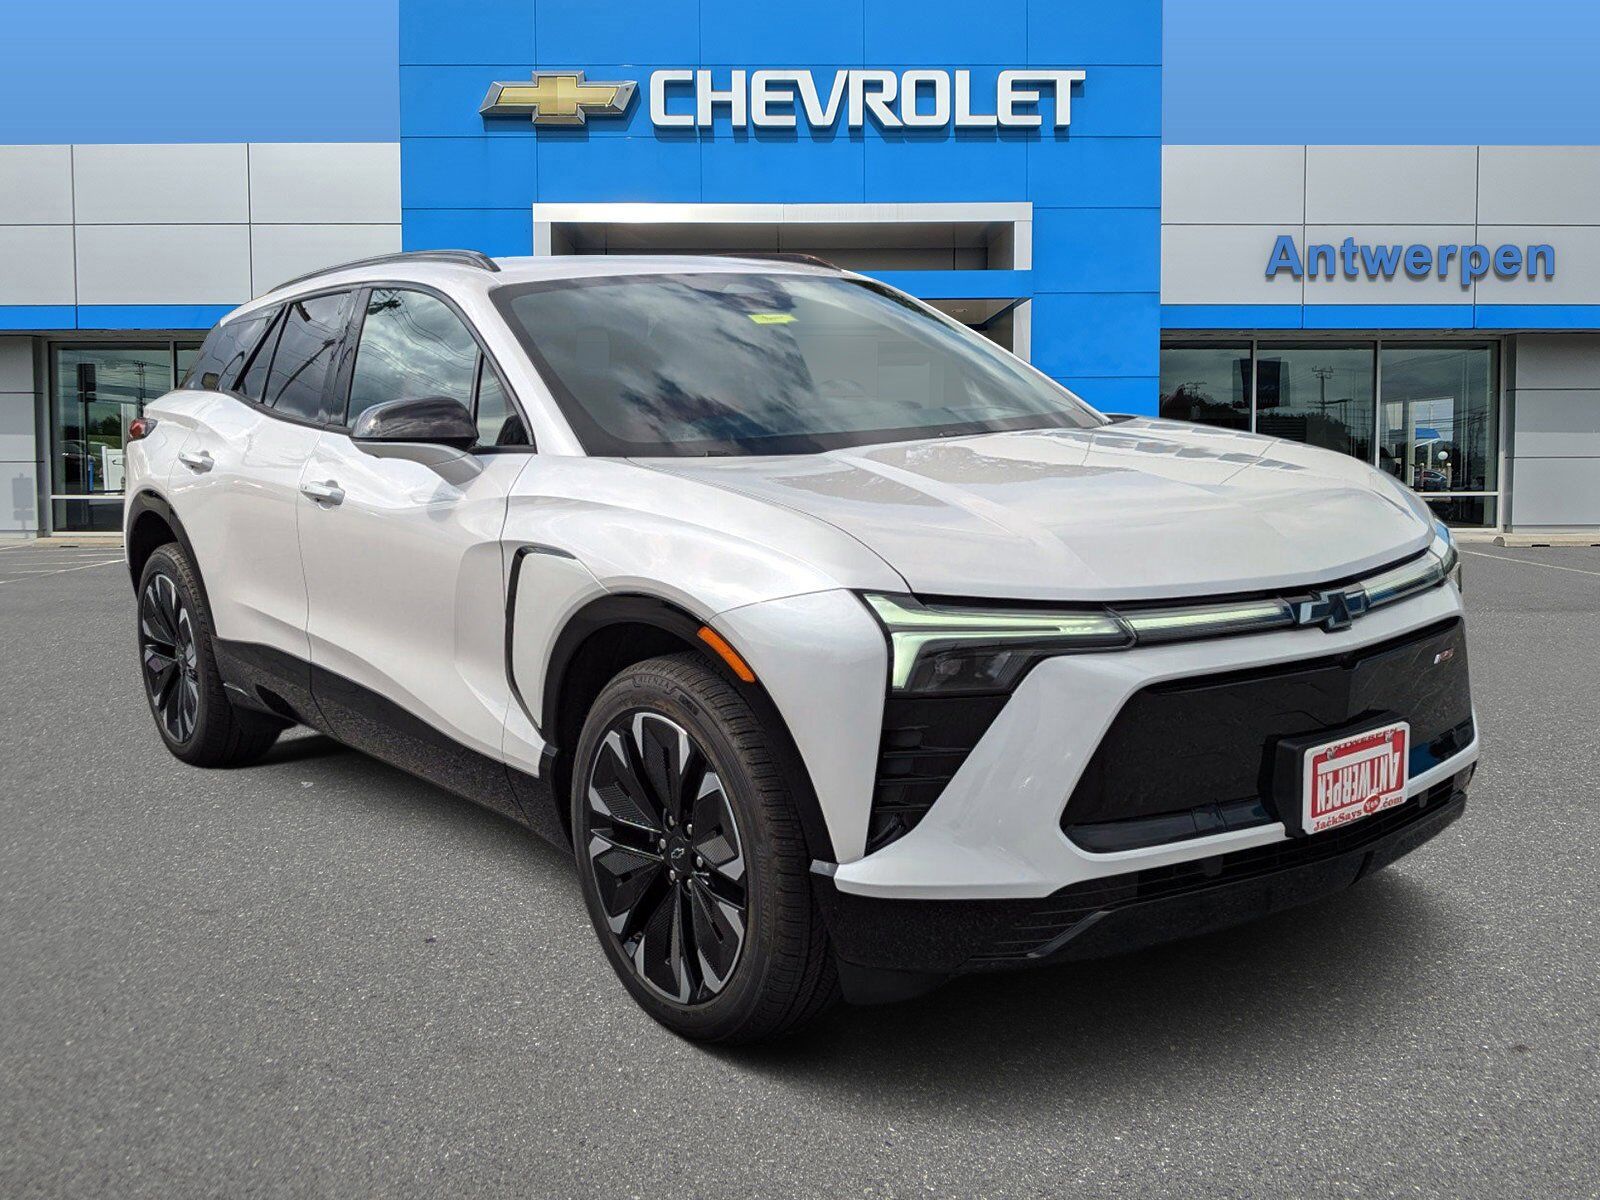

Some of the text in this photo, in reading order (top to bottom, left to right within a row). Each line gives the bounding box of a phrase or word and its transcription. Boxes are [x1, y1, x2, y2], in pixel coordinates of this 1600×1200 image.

[650, 69, 1086, 129] CHEVROLET
[1265, 235, 1555, 287] Antwerpen
[1317, 752, 1400, 813] ANTWERPEN
